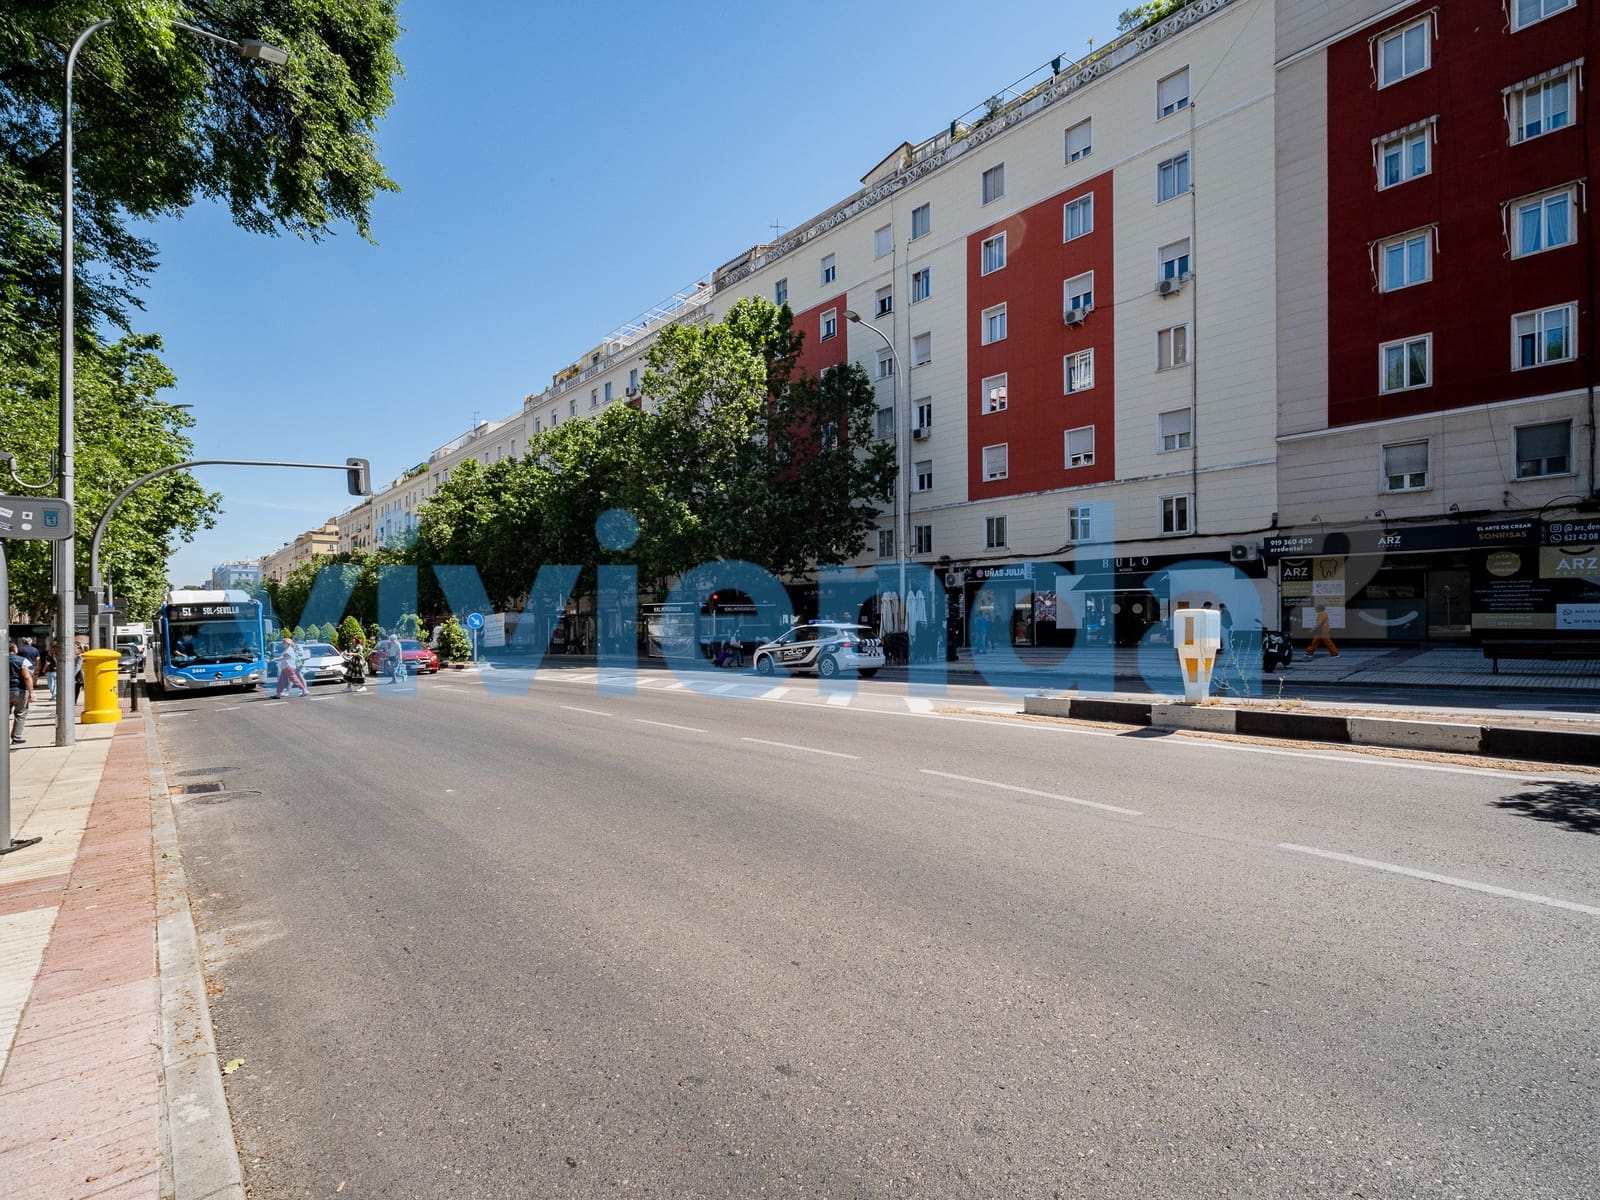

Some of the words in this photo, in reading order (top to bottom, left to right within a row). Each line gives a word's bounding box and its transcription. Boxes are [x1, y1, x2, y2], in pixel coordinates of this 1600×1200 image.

[1378, 536, 1401, 544] ARZ
[1479, 531, 1527, 540] SONRISAS
[1578, 533, 1588, 541] 42
[1283, 538, 1297, 546] 360
[1298, 537, 1313, 545] 420
[1556, 557, 1599, 570] ARZ
[984, 567, 1004, 578] UÑAS
[1283, 567, 1309, 577] ARZ
[182, 607, 193, 616] 51
